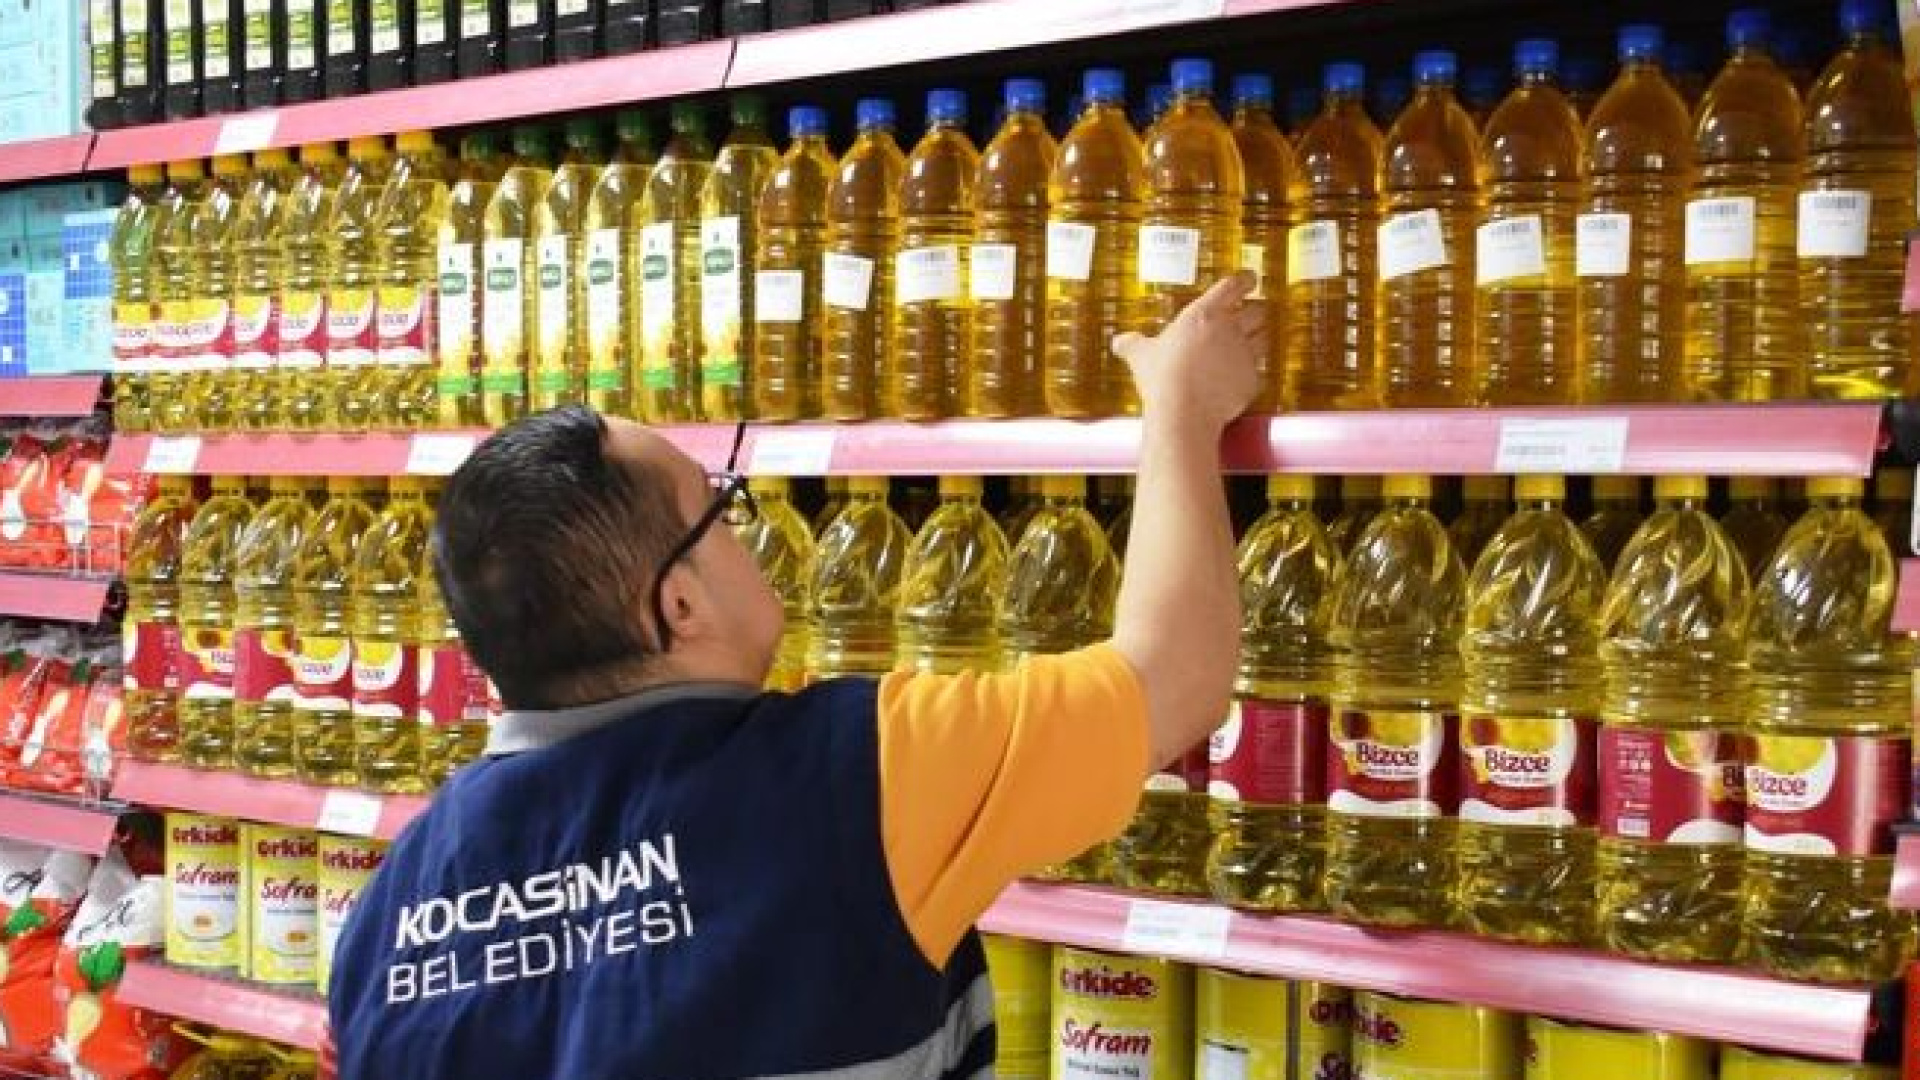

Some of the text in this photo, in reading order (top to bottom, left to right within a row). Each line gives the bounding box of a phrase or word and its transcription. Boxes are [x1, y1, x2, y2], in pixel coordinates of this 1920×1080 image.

[1356, 742, 1419, 766] Bizce
[1485, 748, 1551, 772] Bizce
[261, 877, 318, 900] Sofra
[387, 884, 693, 1004] BELEDİYESİ
[1061, 964, 1159, 998] orkide
[1063, 1018, 1152, 1057] Sofram
